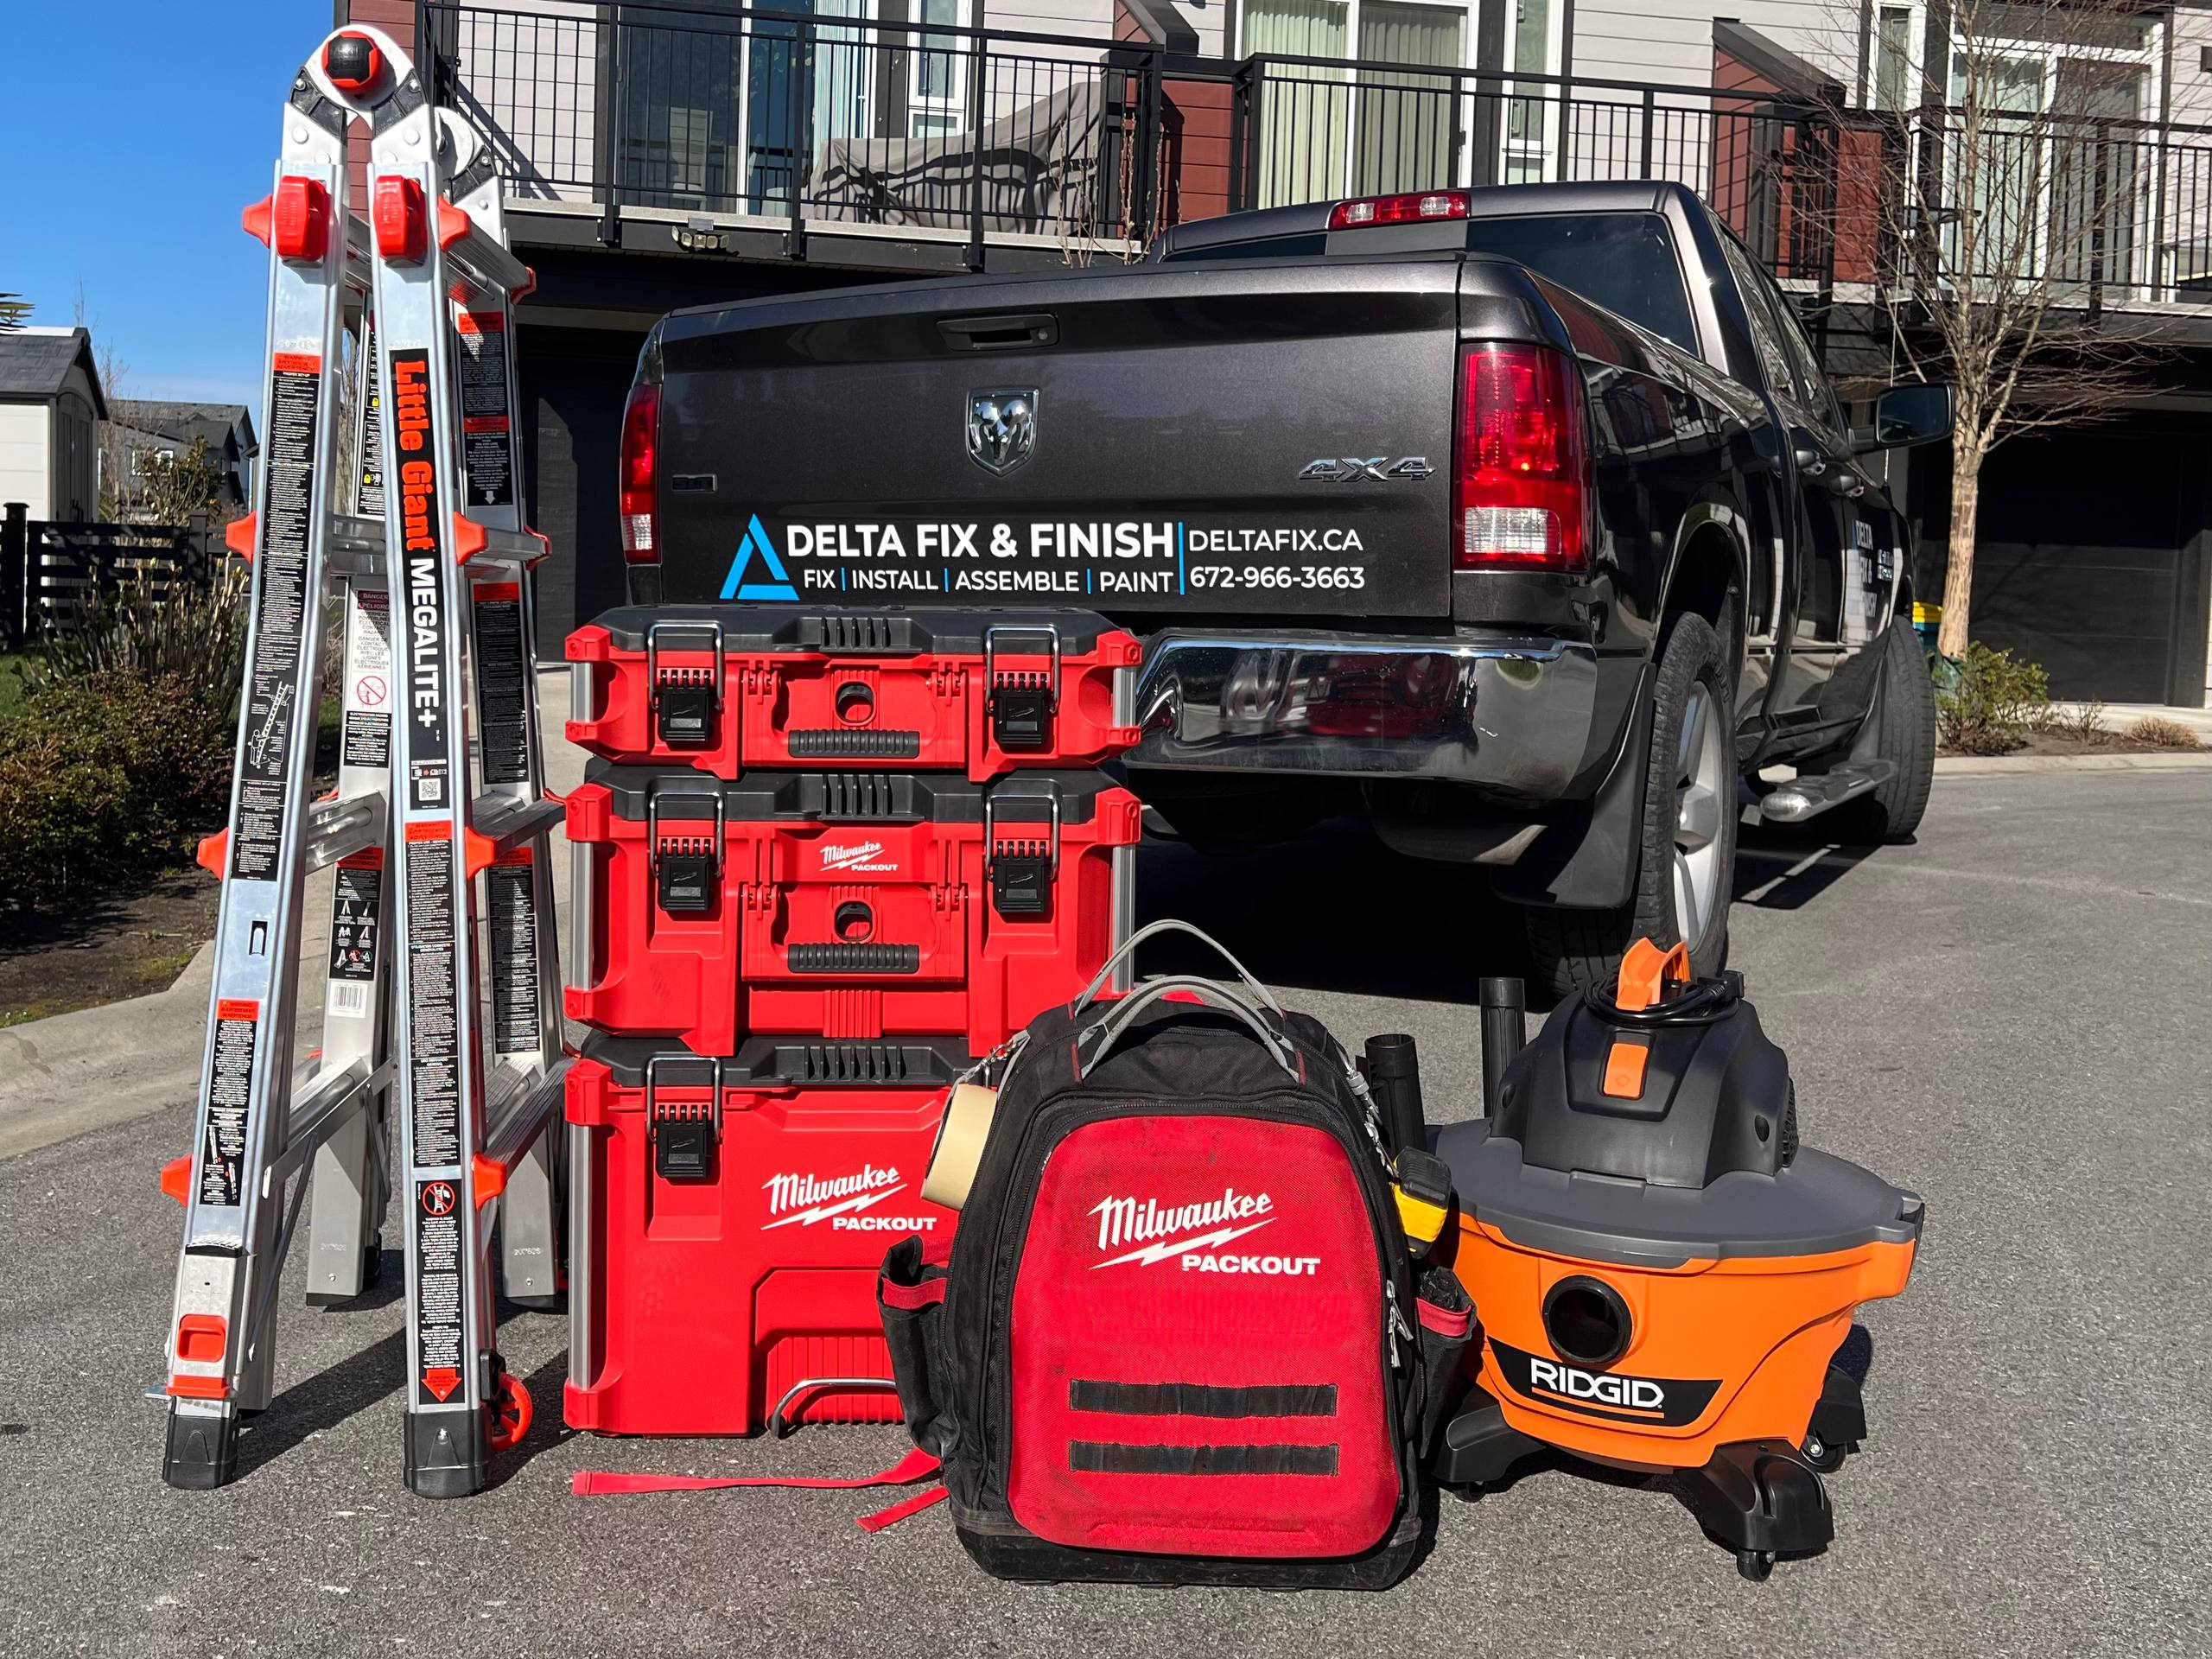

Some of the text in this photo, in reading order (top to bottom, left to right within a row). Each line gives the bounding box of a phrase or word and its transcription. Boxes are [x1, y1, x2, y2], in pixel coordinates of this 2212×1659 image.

[395, 360, 429, 451] Little
[402, 461, 435, 551] Giant
[786, 522, 1173, 558] DELTA FIX & FINISH
[1189, 529, 1363, 551] DELTAFIX.CA
[804, 569, 1174, 593] FIX INSTALL ASSEMBLE PAINT
[1190, 566, 1365, 589] 672-966-3663
[410, 558, 440, 728] MEGALITE+
[819, 841, 882, 865] Milwaukee
[761, 1164, 901, 1216] Milwaukee
[832, 1217, 938, 1230] PACKOUT
[1086, 1188, 1274, 1251] Milwaukee
[1181, 1254, 1321, 1275] PACKOUT
[1530, 1357, 1665, 1408] RIDGID
